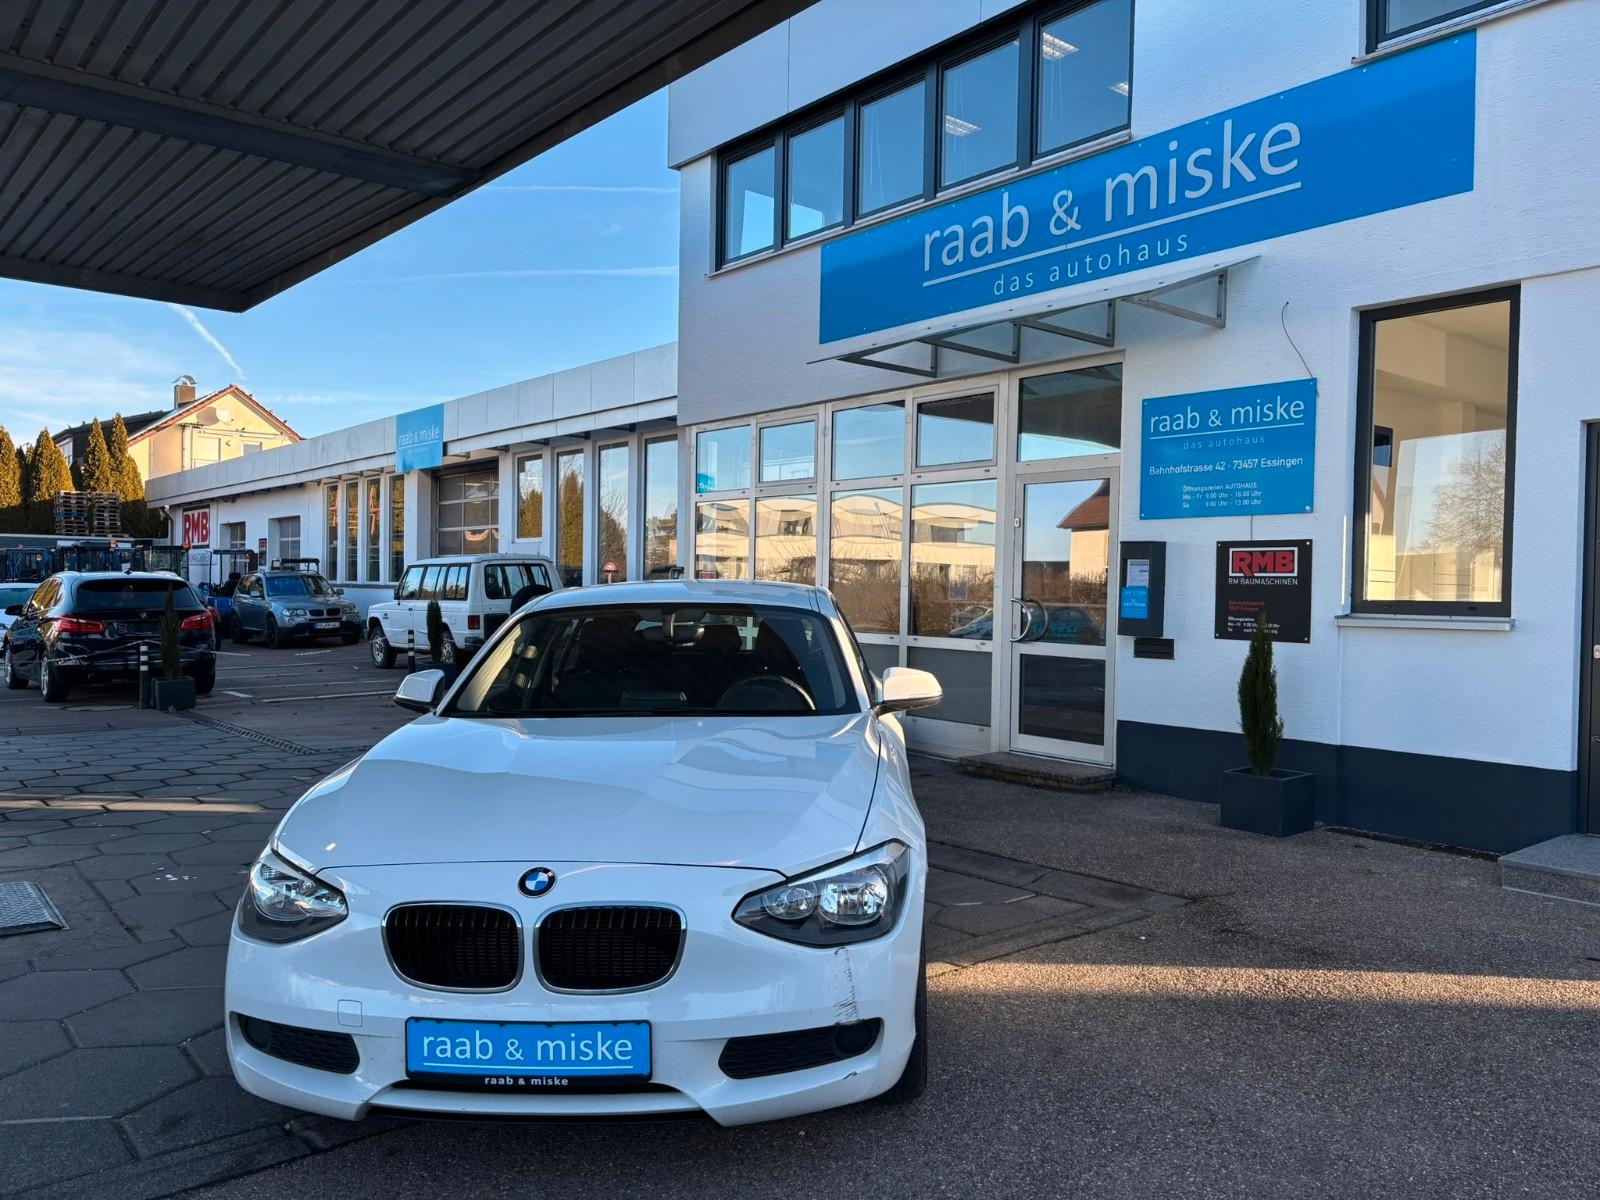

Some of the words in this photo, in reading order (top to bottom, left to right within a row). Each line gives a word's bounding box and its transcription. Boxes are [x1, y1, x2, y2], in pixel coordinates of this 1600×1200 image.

[924, 192, 1029, 271] raab
[1049, 189, 1081, 236] &
[1105, 120, 1301, 222] miske
[994, 274, 1034, 296] das
[1050, 234, 1188, 282] autohaus
[1150, 406, 1200, 433] raab
[1208, 409, 1223, 427] &
[1231, 395, 1305, 425] miske
[1183, 440, 1203, 450] das
[1208, 435, 1265, 448] autohaus
[1149, 463, 1214, 476] Bahnhofstrasse
[1215, 461, 1226, 471] 42
[1232, 459, 1259, 470] 73457
[1260, 457, 1304, 469] Essingen
[184, 511, 209, 544] RMB
[1232, 551, 1294, 577] RMB
[1240, 577, 1298, 585] BAUMASCHINEN
[423, 1030, 493, 1061] raab
[505, 1038, 525, 1061] &
[537, 1032, 633, 1062] miske
[484, 1076, 514, 1086] raab
[530, 1076, 569, 1087] miske
